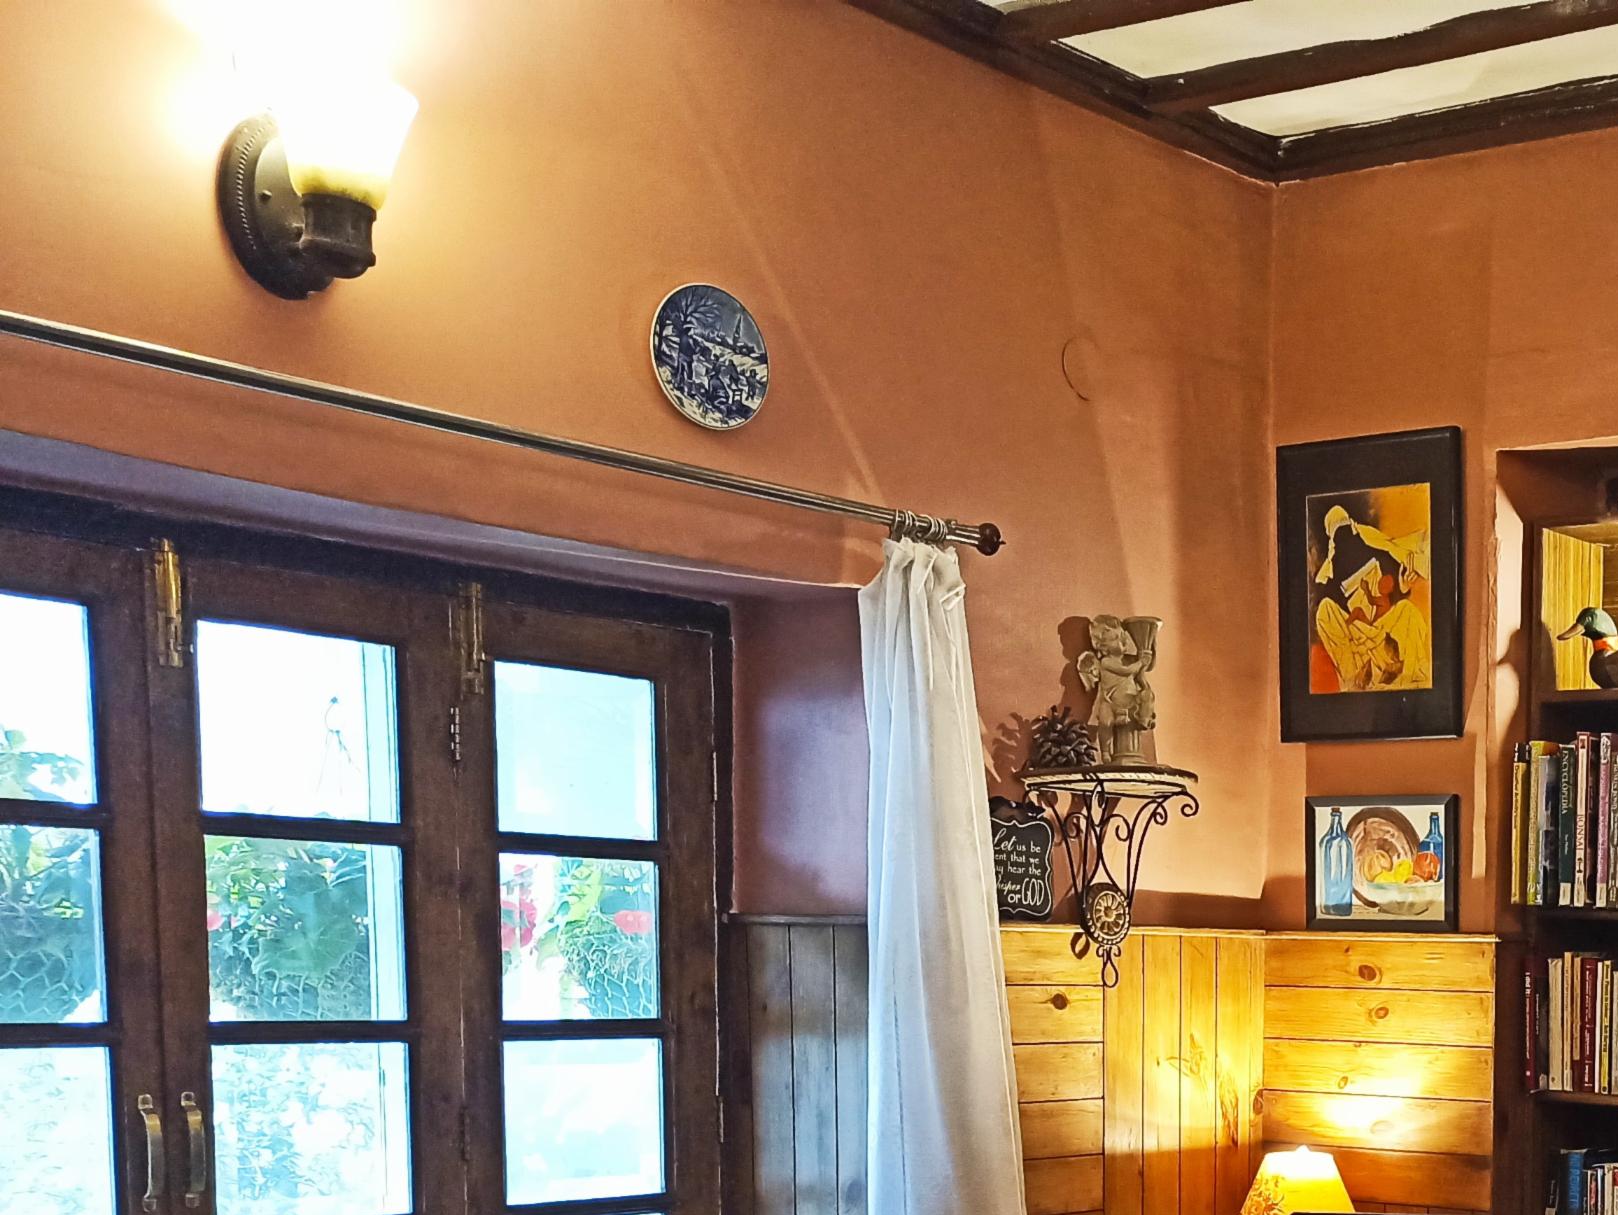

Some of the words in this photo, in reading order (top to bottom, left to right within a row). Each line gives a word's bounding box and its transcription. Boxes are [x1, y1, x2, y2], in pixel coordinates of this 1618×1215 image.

[993, 827, 1016, 851] Let
[1030, 840, 1041, 853] be
[1010, 851, 1026, 863] that
[1007, 861, 1026, 874] hear
[1029, 863, 1042, 876] the
[1022, 877, 1045, 906] GOD
